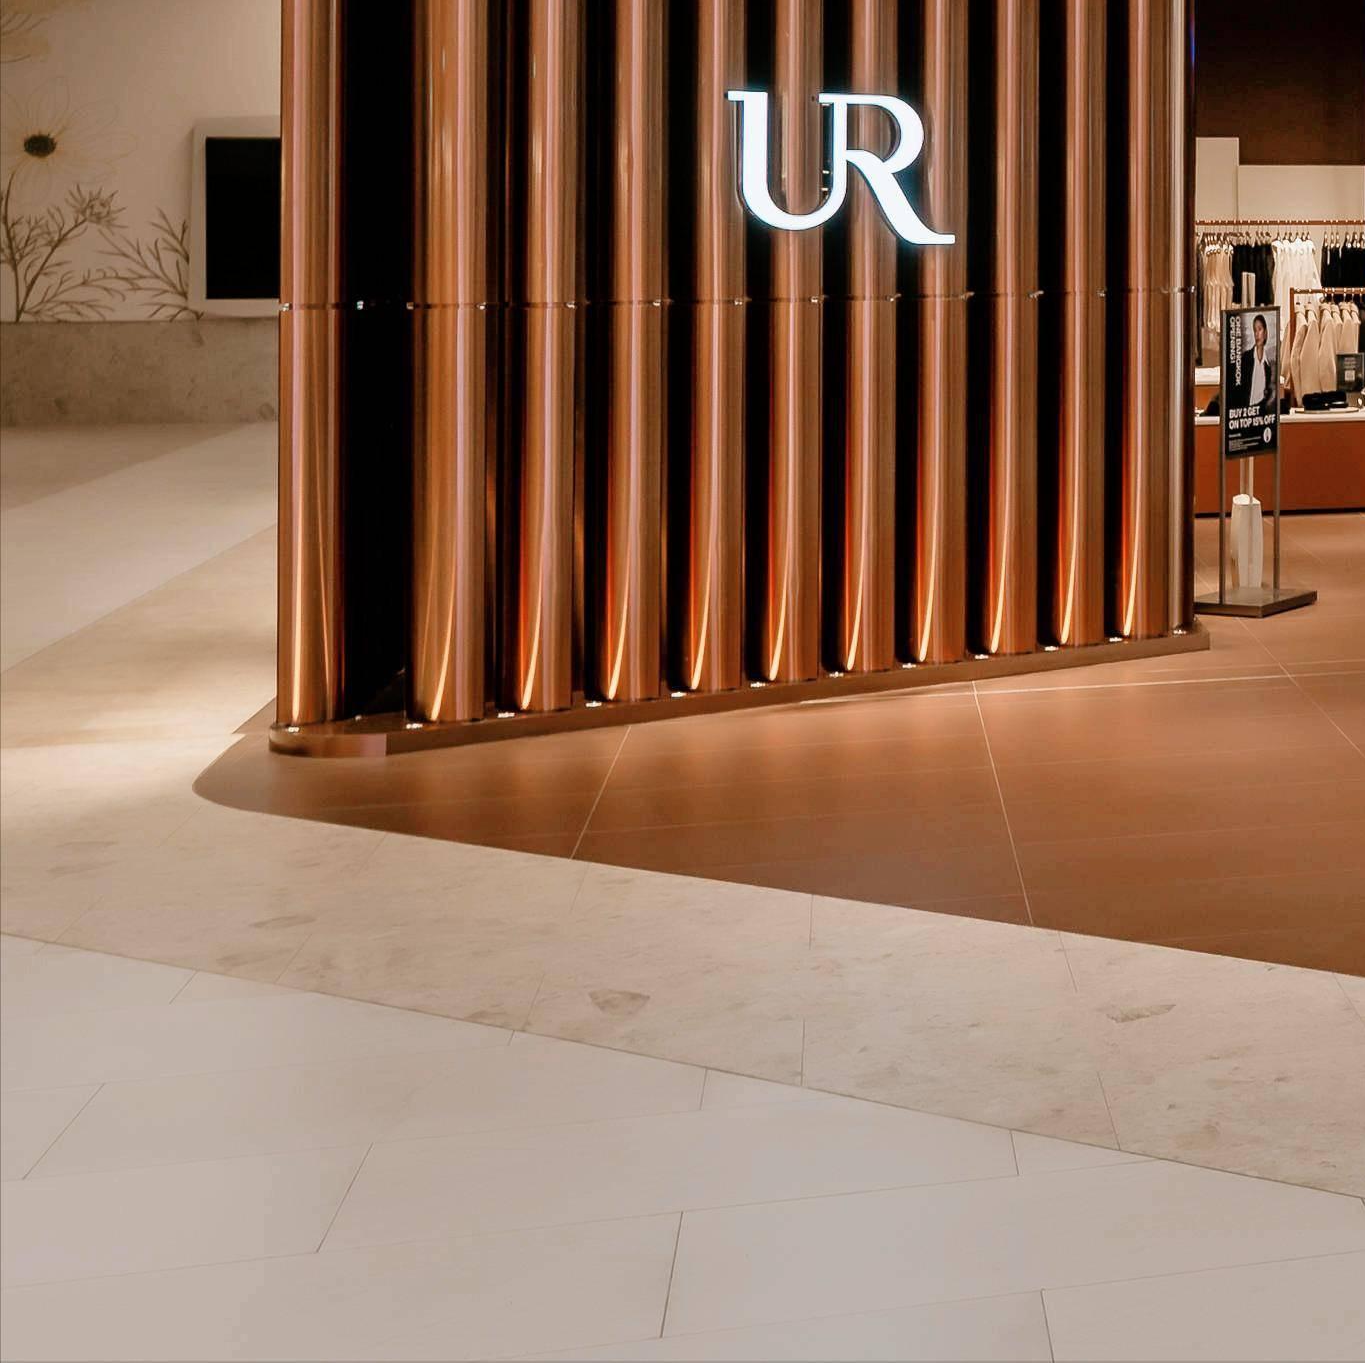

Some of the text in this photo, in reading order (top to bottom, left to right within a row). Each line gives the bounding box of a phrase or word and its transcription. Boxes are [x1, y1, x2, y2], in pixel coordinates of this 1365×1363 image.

[727, 90, 956, 245] UR
[1229, 409, 1242, 419] BUY
[1248, 406, 1260, 416] GET
[1229, 419, 1239, 429] ON
[1240, 418, 1252, 428] TOP
[1264, 414, 1276, 425] OFF
